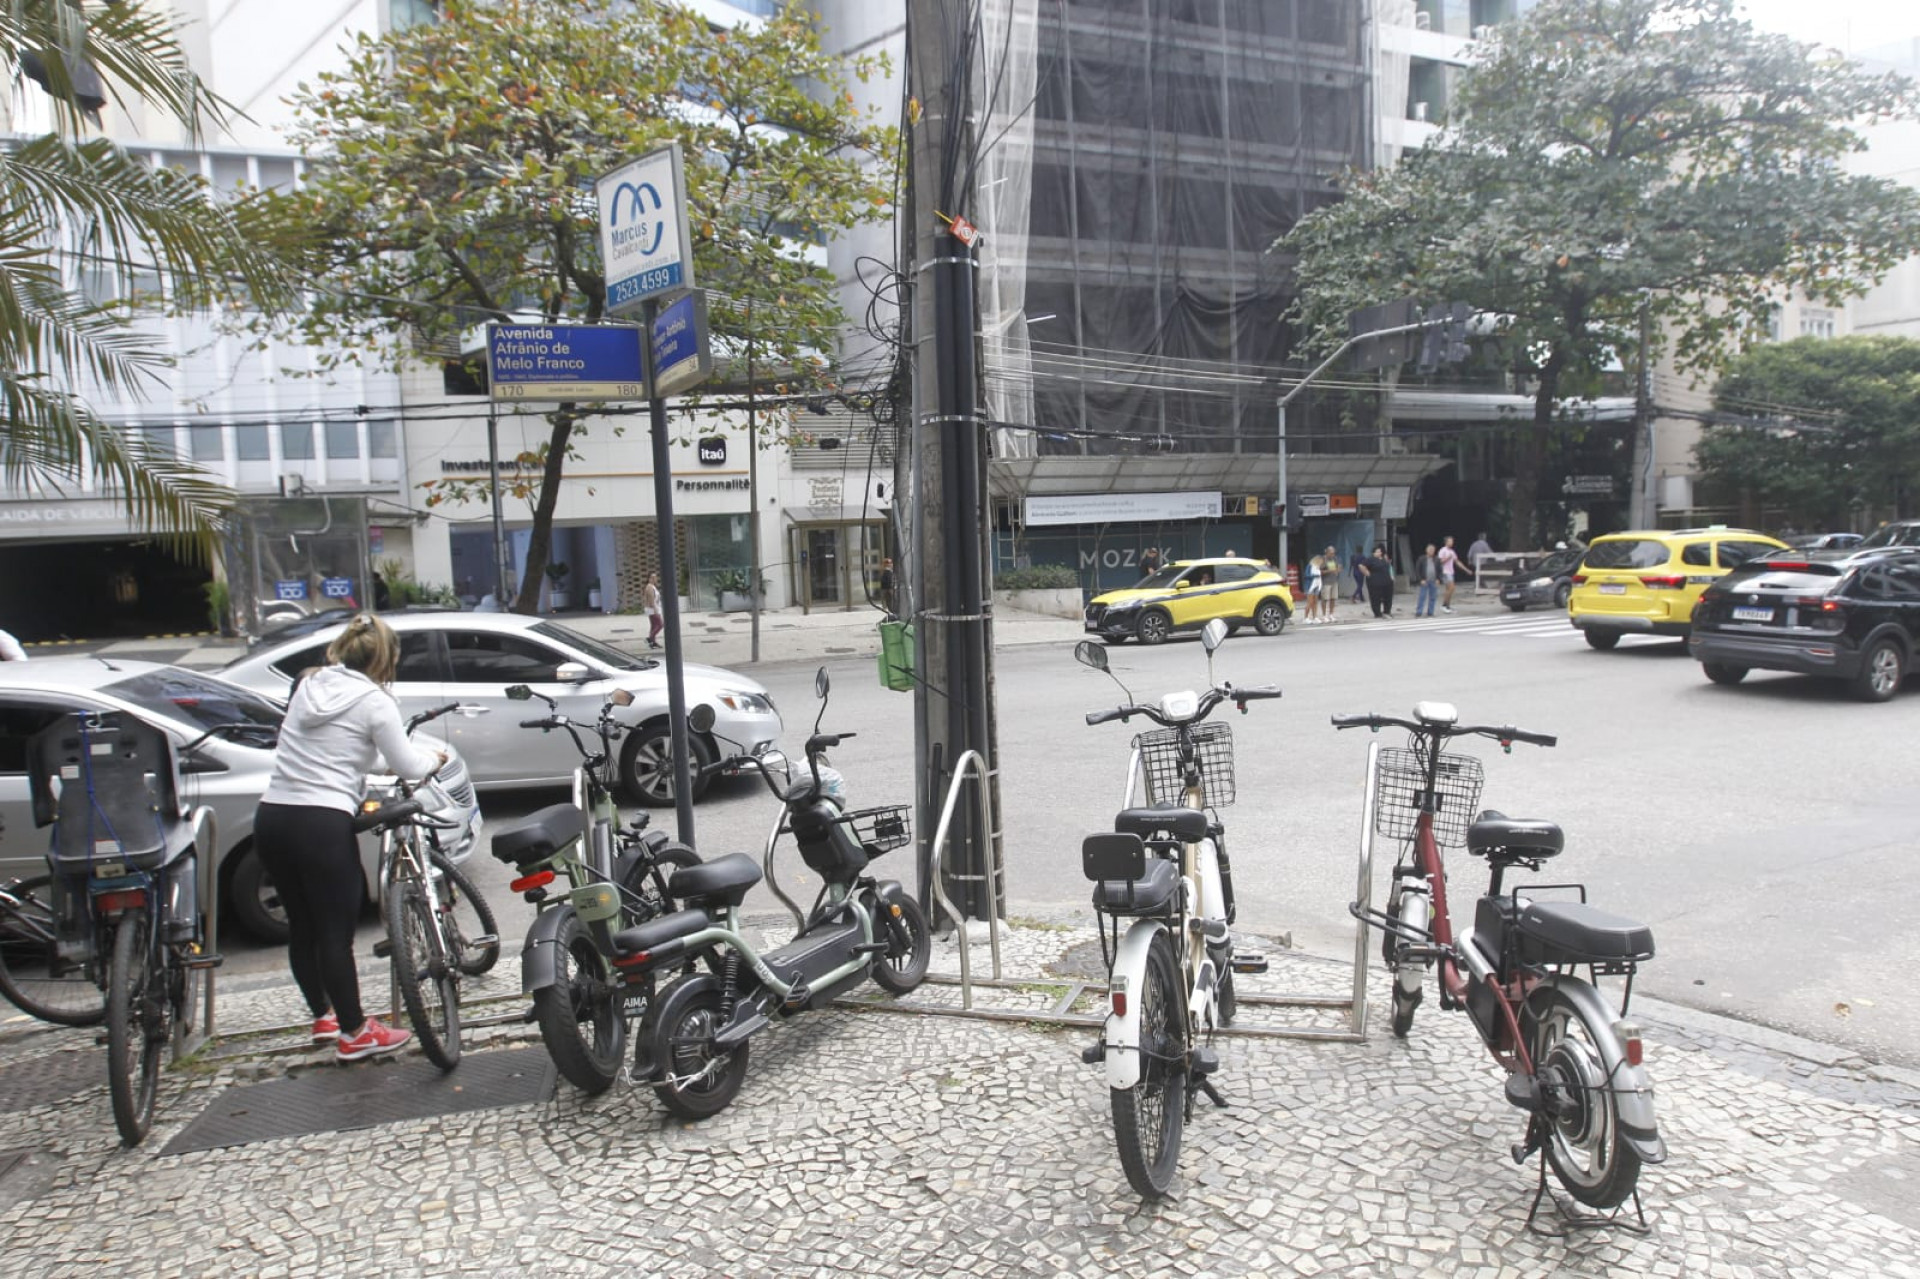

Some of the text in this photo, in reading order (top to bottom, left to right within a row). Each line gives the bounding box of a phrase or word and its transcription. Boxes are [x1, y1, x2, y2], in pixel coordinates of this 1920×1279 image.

[611, 222, 648, 247] Marcus
[615, 268, 669, 302] 2523.4599
[494, 327, 553, 339] Avenida
[496, 341, 570, 354] Afrânio de
[497, 356, 585, 369] Melo Franco
[502, 385, 524, 397] 170
[617, 384, 638, 396] 180
[701, 447, 724, 460] itaú
[1, 508, 42, 522] AIDA
[623, 996, 648, 1008] AIMA
